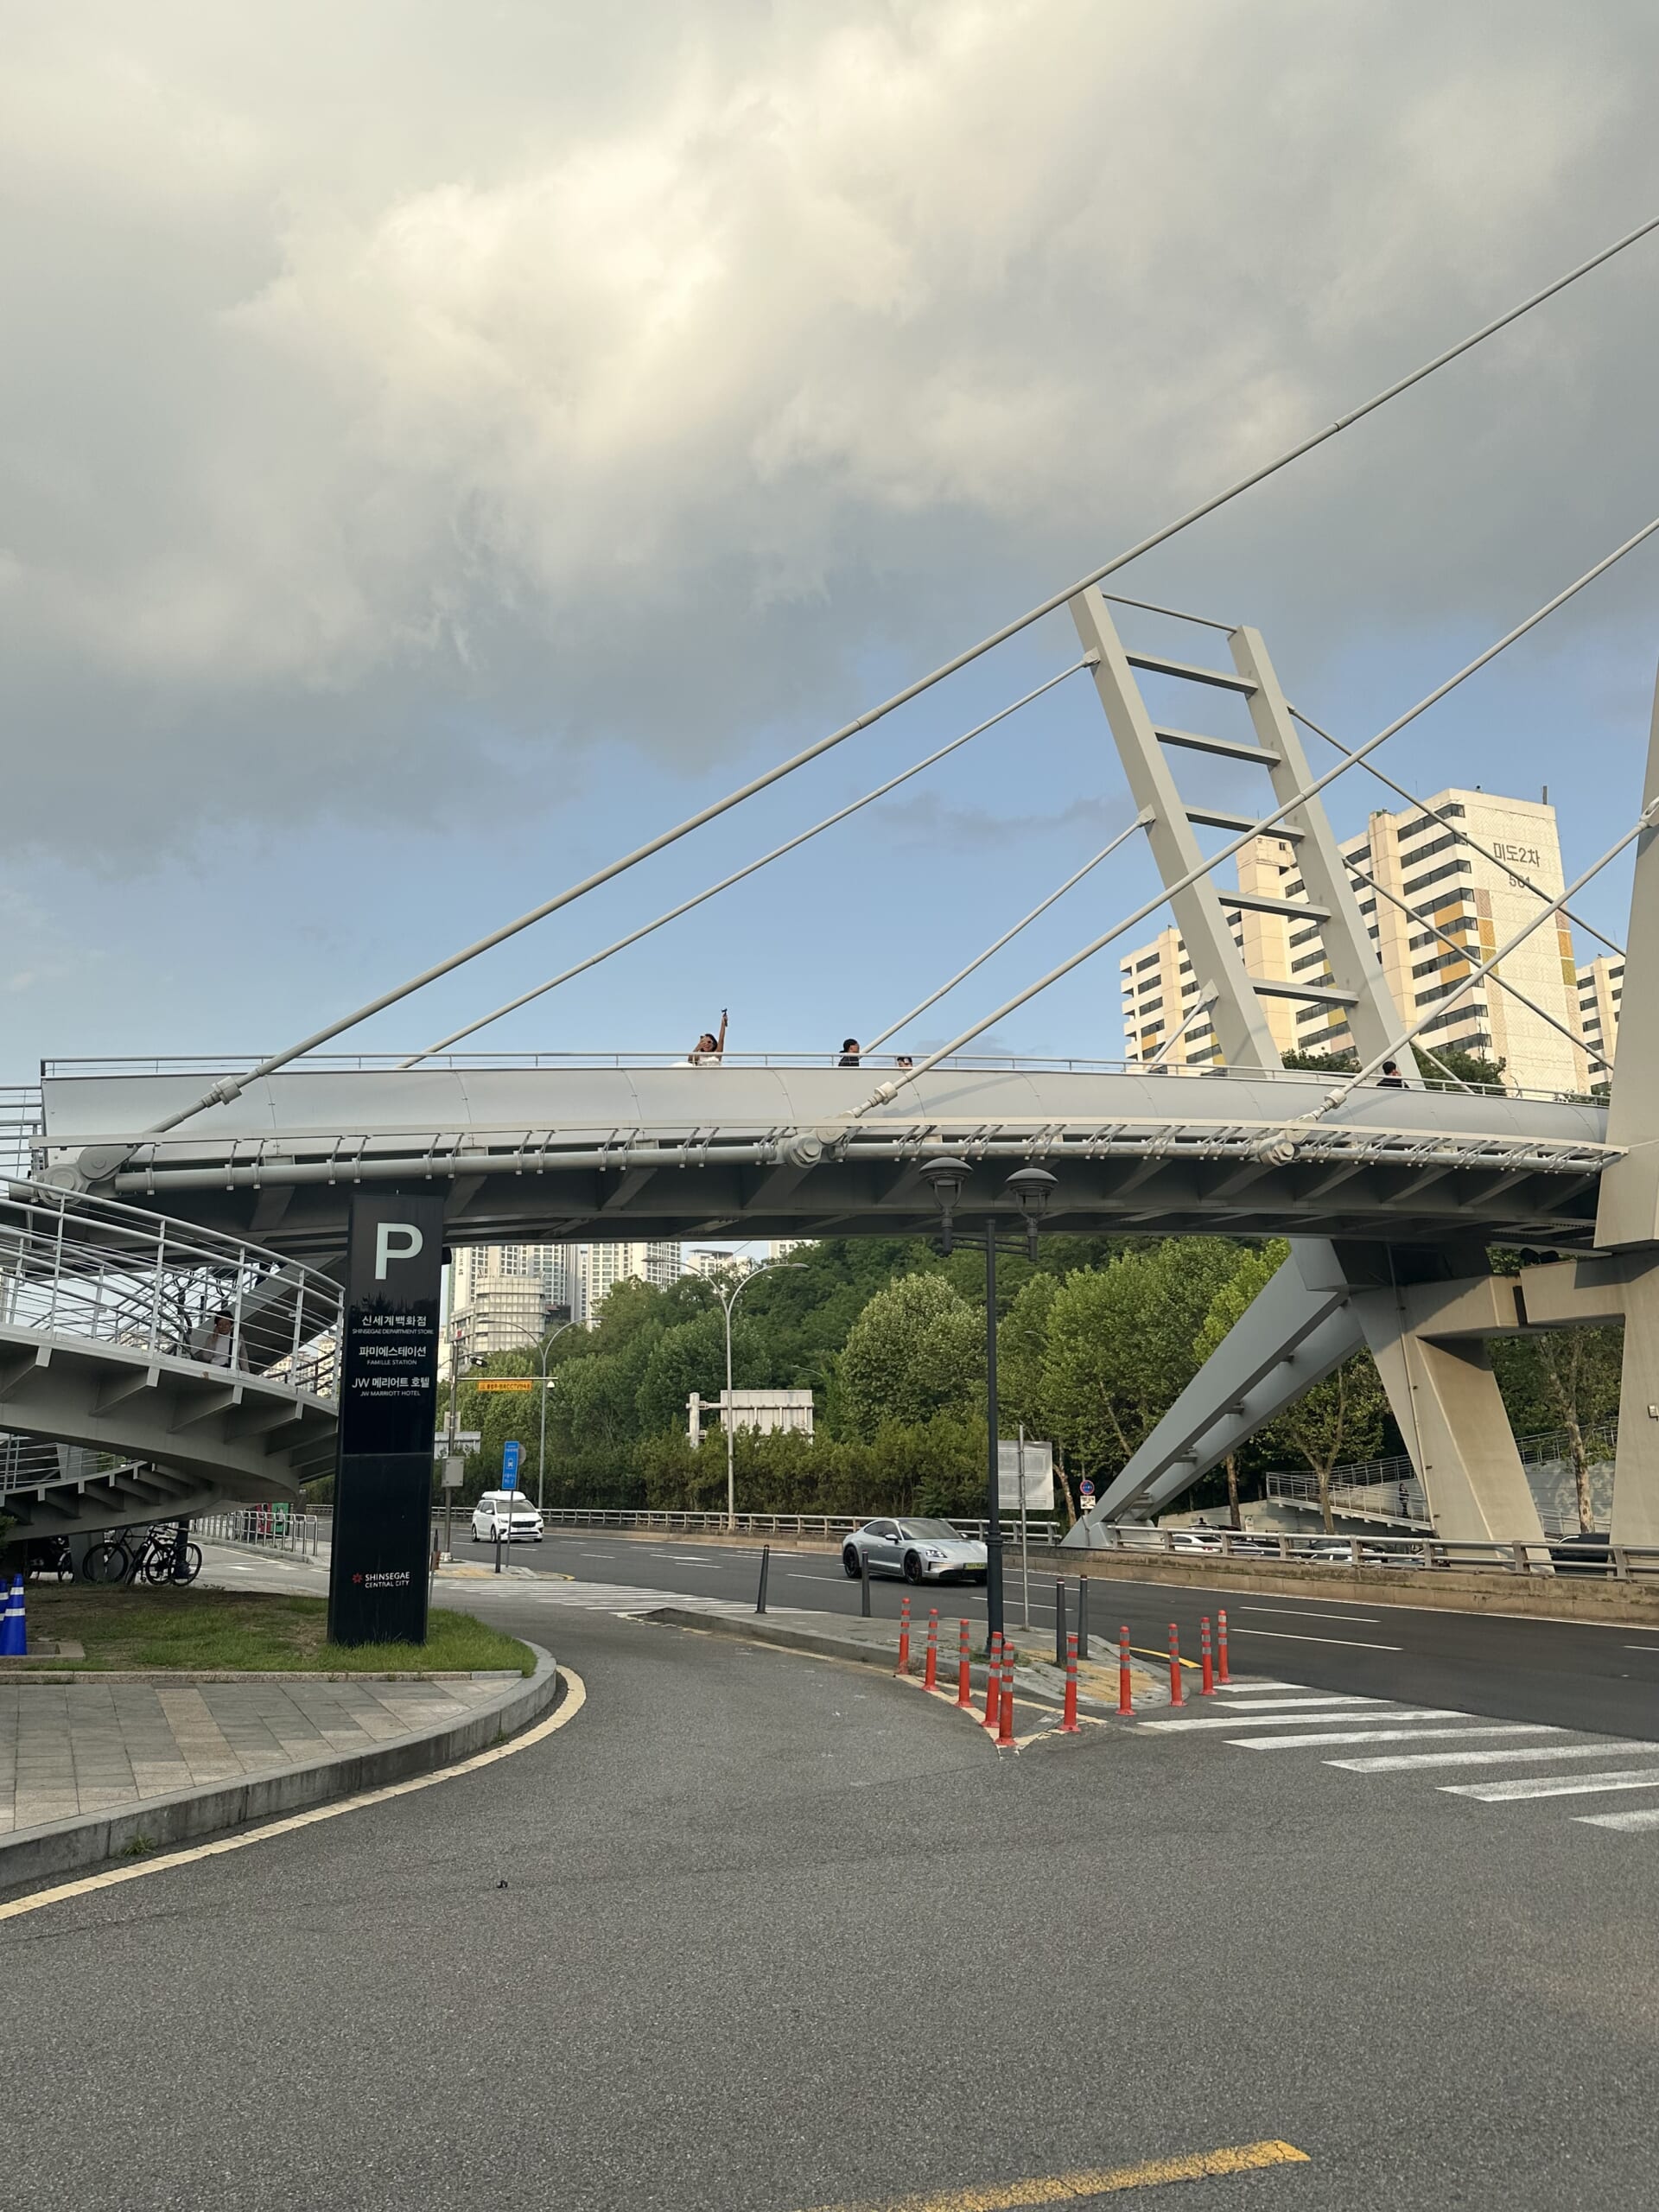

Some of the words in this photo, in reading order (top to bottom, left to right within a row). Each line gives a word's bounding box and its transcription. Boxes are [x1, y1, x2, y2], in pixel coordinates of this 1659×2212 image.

[1493, 842, 1541, 868] 미도2차
[374, 1222, 423, 1280] P
[361, 1315, 427, 1326] 신세계백화점
[359, 1345, 427, 1357] 파미에스테이션
[352, 1377, 370, 1389] JW
[372, 1376, 409, 1388] 메리어트
[410, 1376, 429, 1388] 호텔
[365, 1571, 410, 1581] SHINSEGAE
